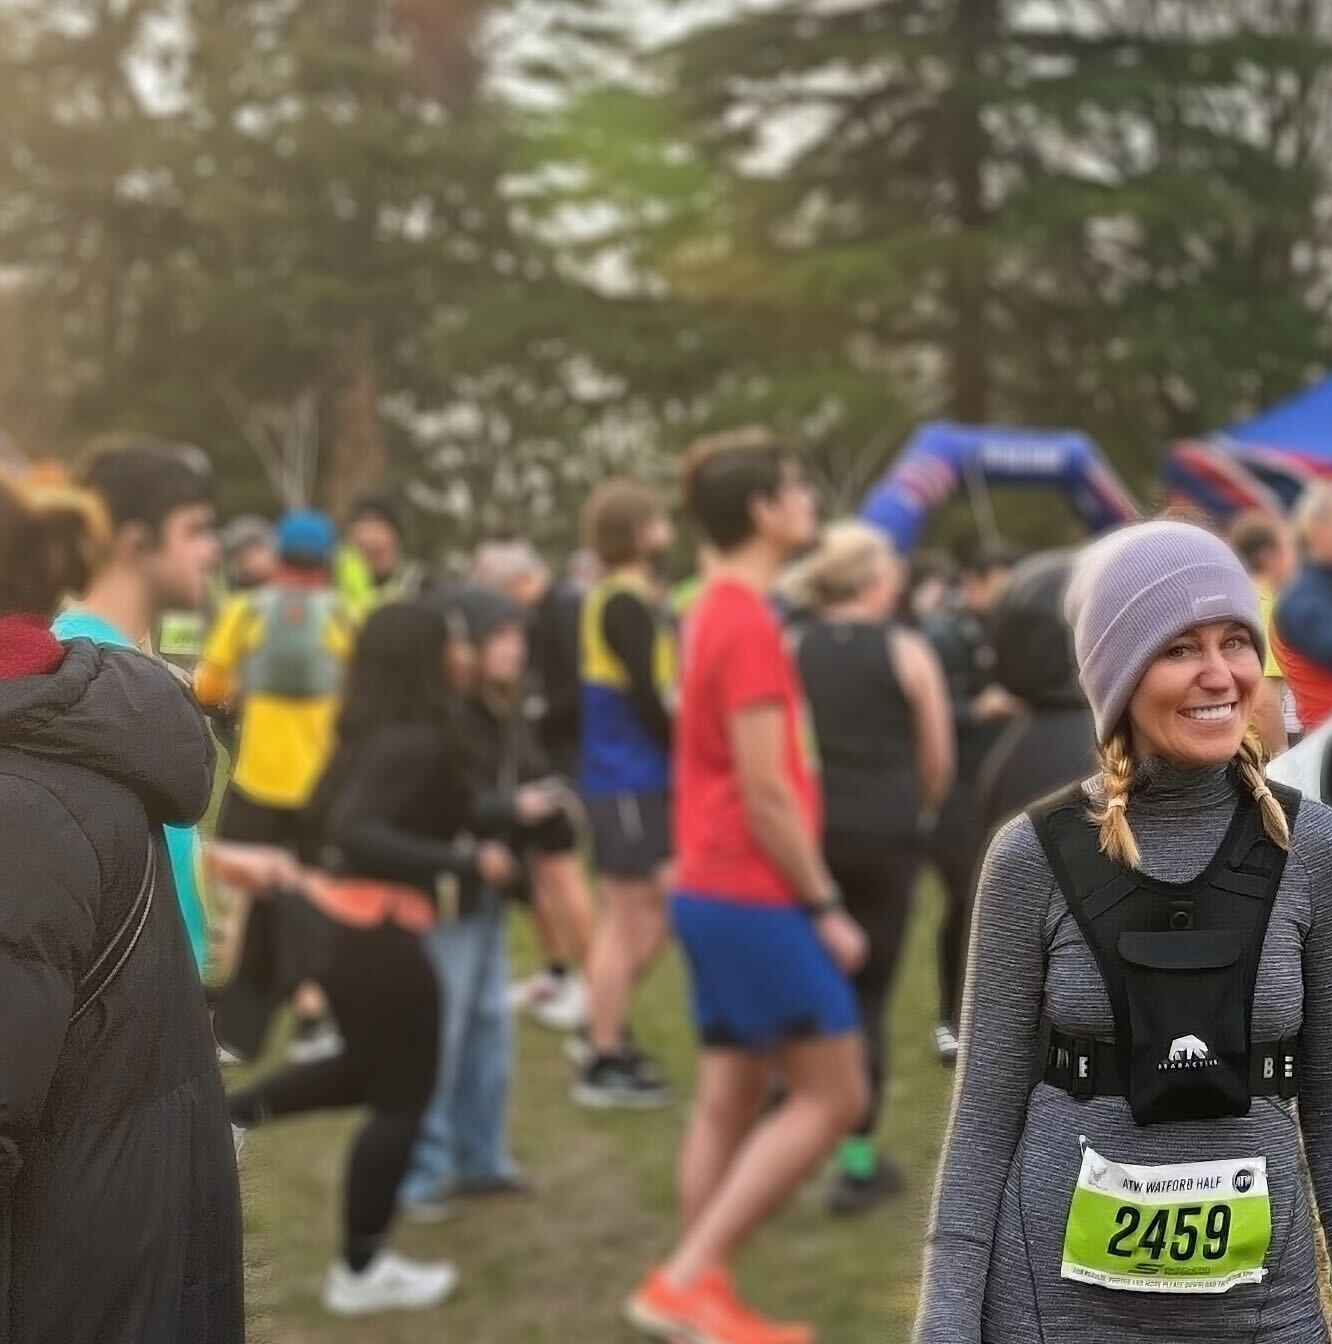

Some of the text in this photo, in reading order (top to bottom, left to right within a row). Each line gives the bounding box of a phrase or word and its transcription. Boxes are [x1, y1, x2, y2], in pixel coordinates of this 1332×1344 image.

[1122, 1176, 1222, 1194] ATW WATFORD HALF
[1106, 1204, 1232, 1261] 2459
